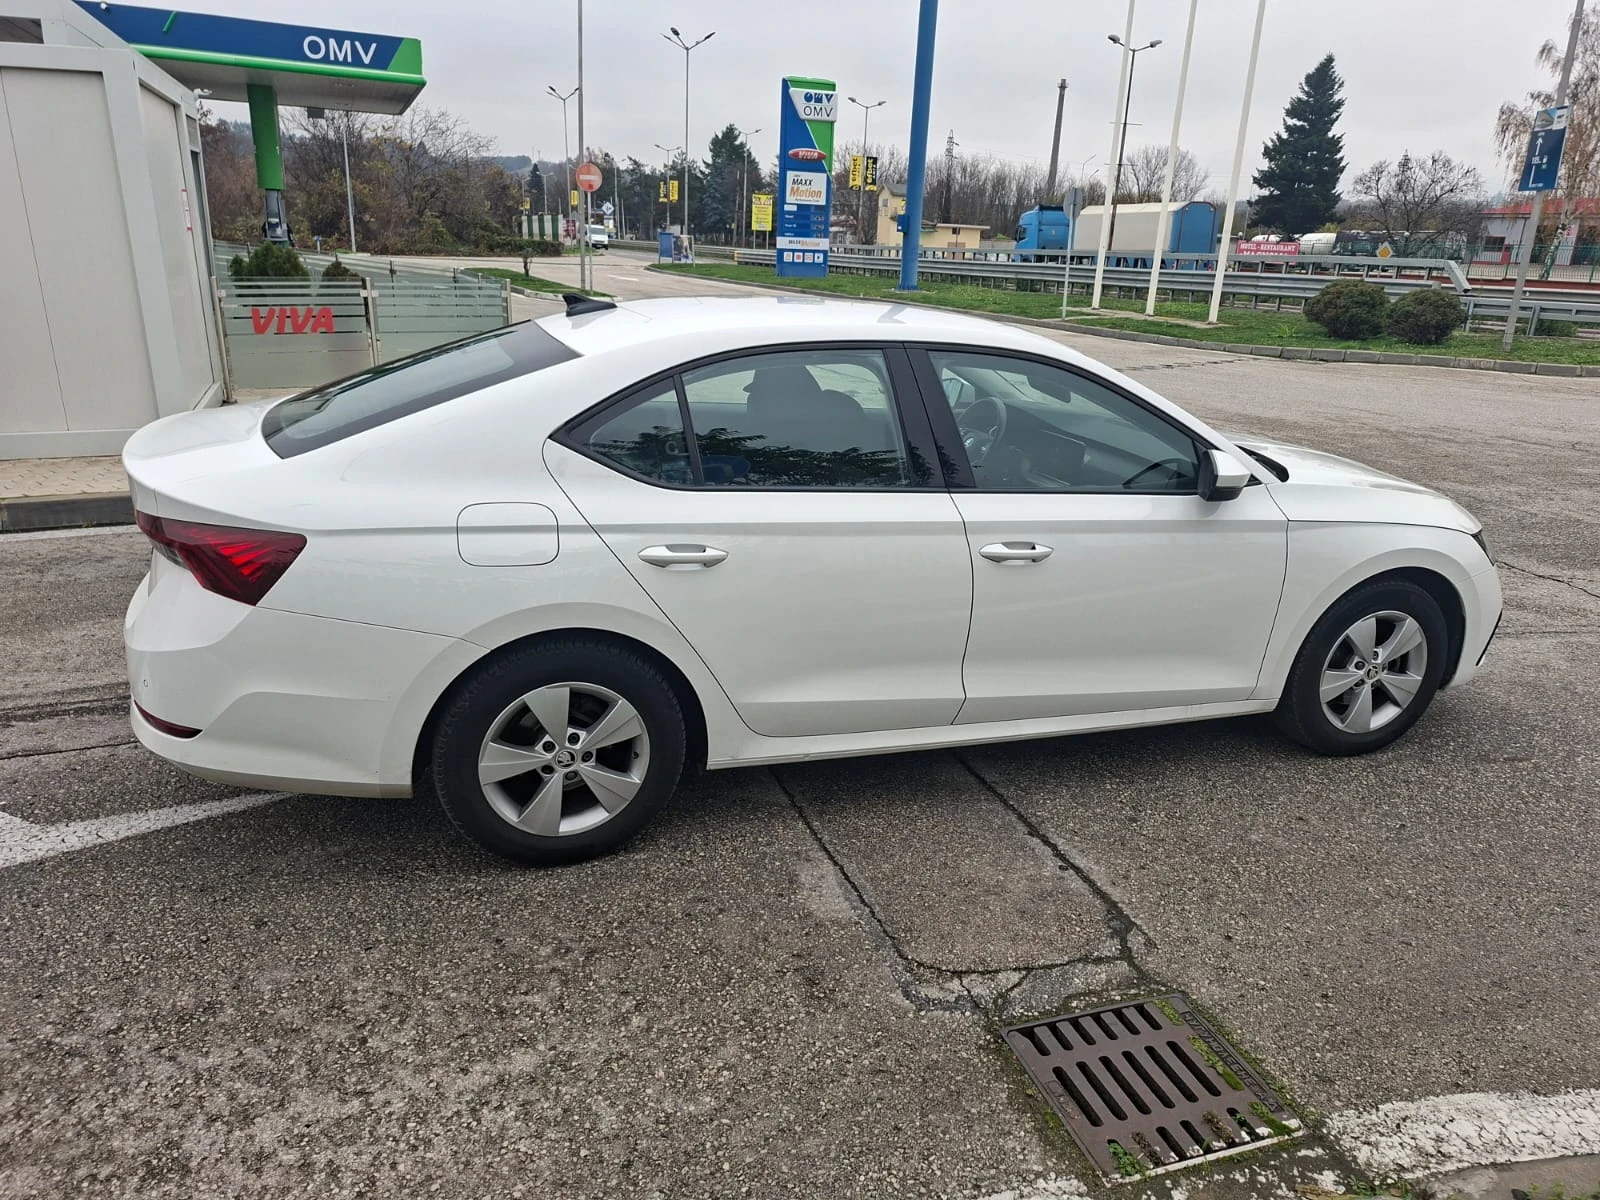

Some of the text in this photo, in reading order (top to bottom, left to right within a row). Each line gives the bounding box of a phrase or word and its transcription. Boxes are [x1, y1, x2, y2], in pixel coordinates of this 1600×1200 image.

[303, 35, 377, 64] OMV
[803, 105, 833, 118] OMV
[798, 151, 818, 160] VIVA
[792, 178, 814, 186] MAXX
[790, 186, 822, 199] Motion
[1260, 244, 1297, 252] RESTAURANT
[251, 306, 335, 335] VIVA
